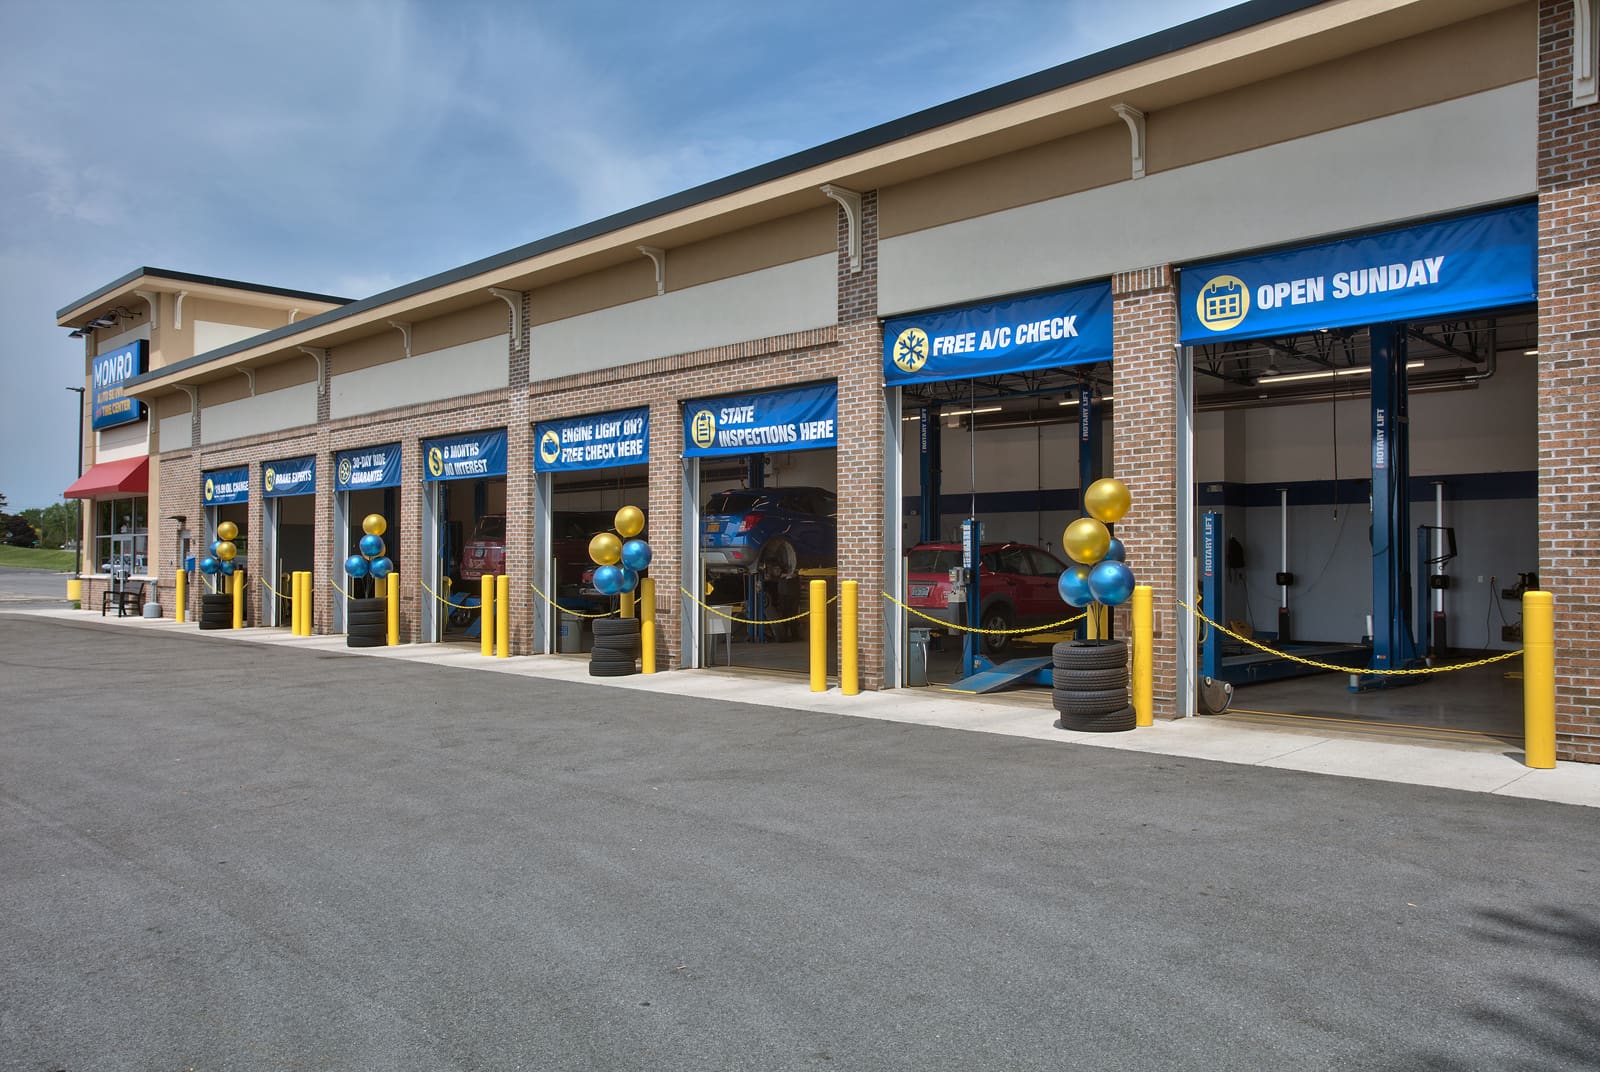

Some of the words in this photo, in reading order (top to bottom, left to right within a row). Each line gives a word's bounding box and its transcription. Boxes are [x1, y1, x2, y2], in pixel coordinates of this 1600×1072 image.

[1257, 276, 1324, 310] OPEN
[1332, 256, 1445, 299] SUNDAY
[933, 332, 976, 356] FREE
[979, 327, 1011, 351] A/C
[1015, 315, 1078, 345] CHECK
[95, 352, 133, 389] MONRO
[719, 406, 754, 425] STATE
[1376, 408, 1385, 427] LIFT
[562, 425, 593, 443] ENGINE
[595, 421, 621, 439] LIGHT
[623, 418, 643, 436] ON?
[719, 424, 797, 447] INSPECTIONS
[800, 419, 834, 441] HERE
[444, 449, 449, 458] 6
[451, 442, 479, 458] MONTHS
[561, 447, 584, 463] FREE
[585, 443, 615, 461] CHECK
[617, 439, 643, 457] HERE
[1376, 429, 1385, 464] ROTARY
[444, 462, 454, 476] NO
[455, 459, 488, 475] INTEREST
